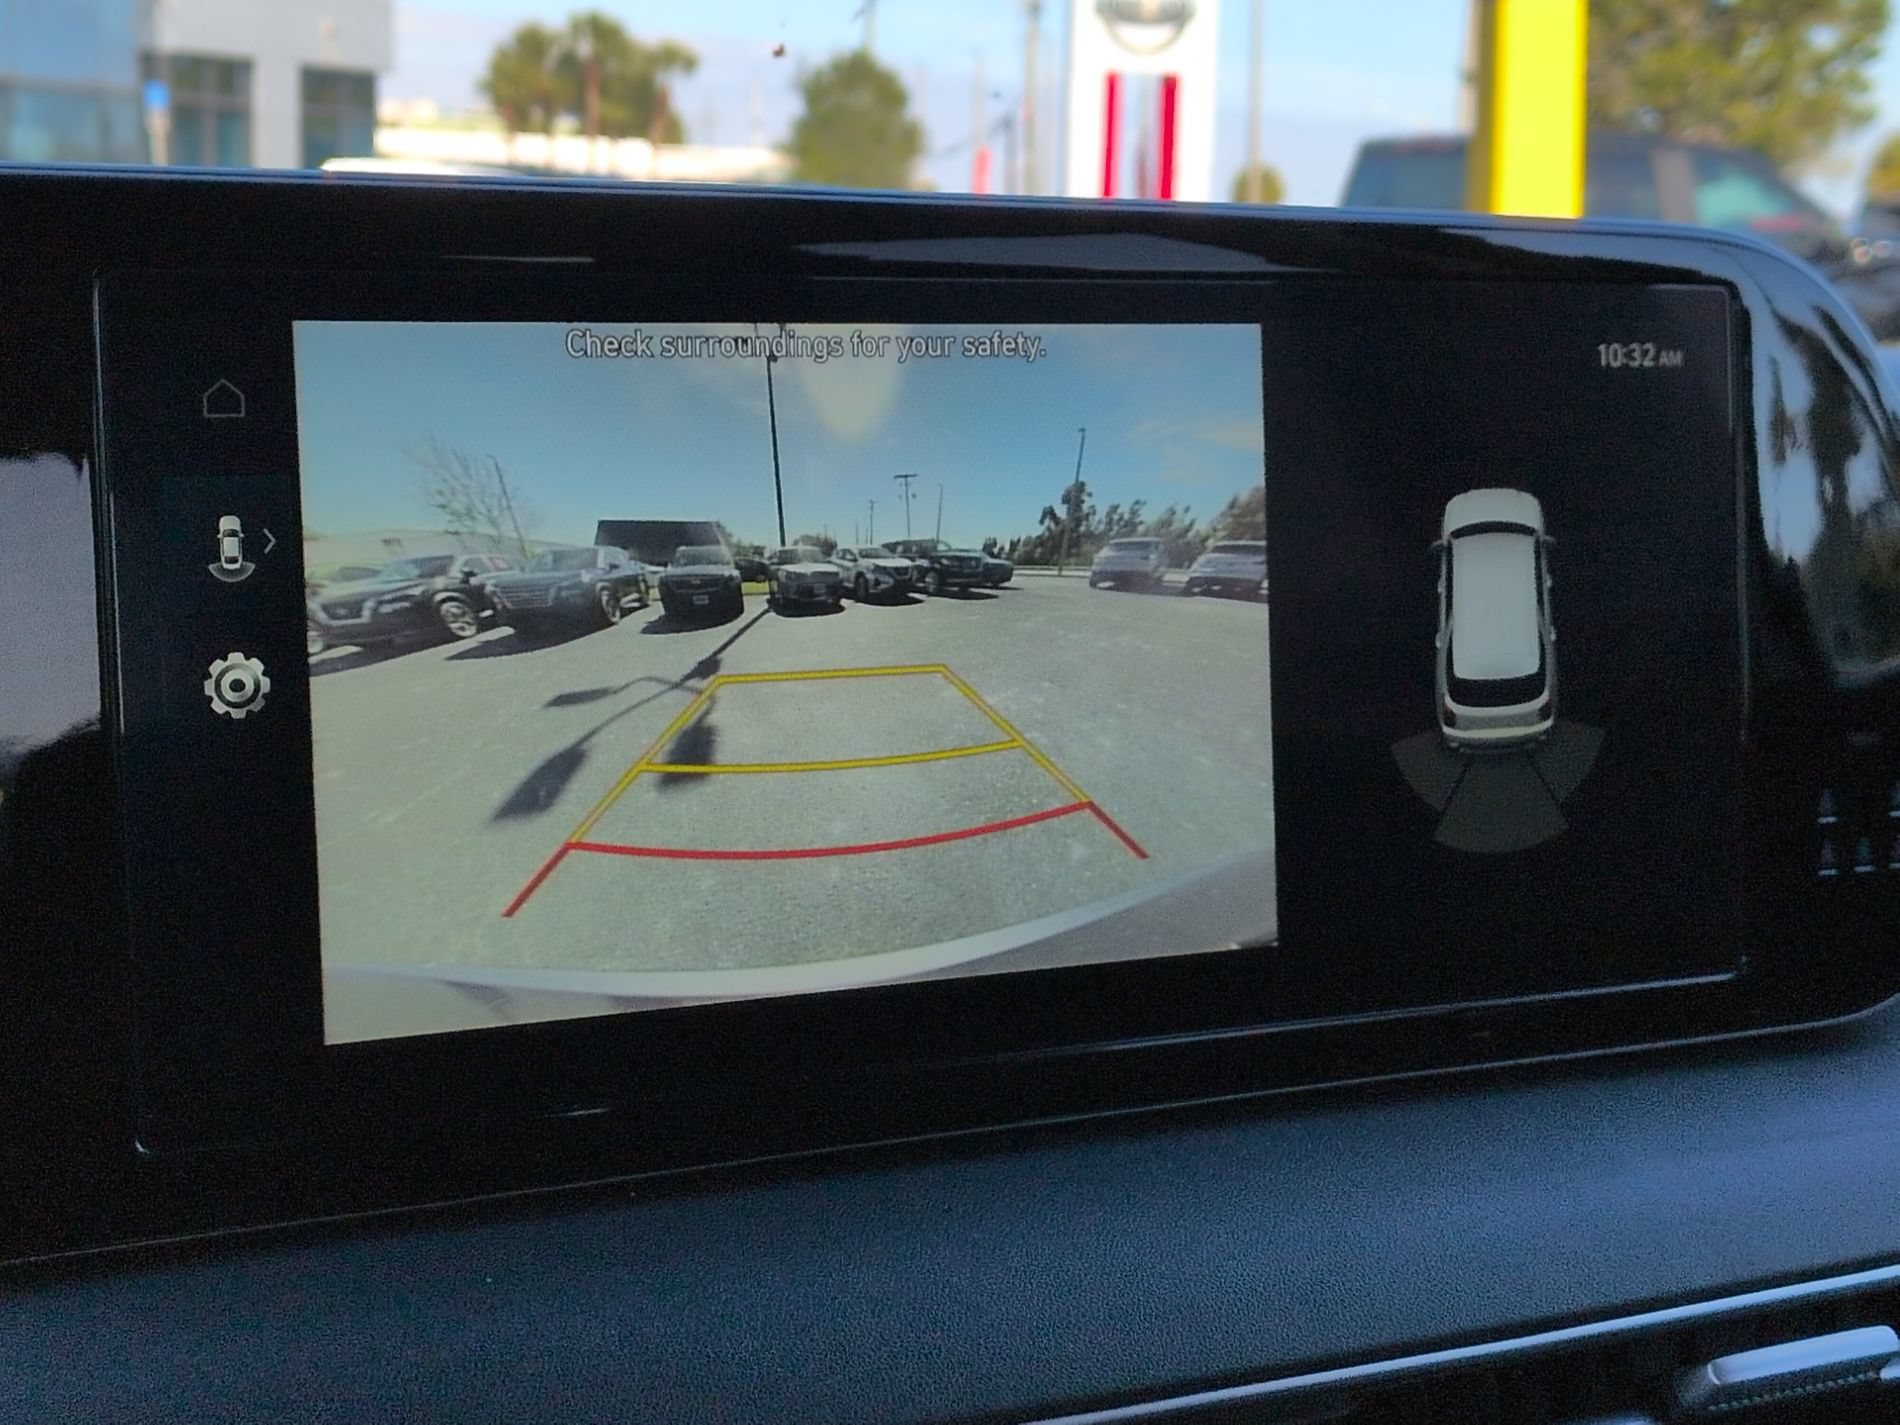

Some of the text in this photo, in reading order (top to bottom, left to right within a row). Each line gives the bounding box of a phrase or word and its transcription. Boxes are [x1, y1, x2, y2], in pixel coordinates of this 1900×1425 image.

[566, 328, 1047, 363] Check surroundings for your safety.
[1598, 342, 1656, 368] 10:32
